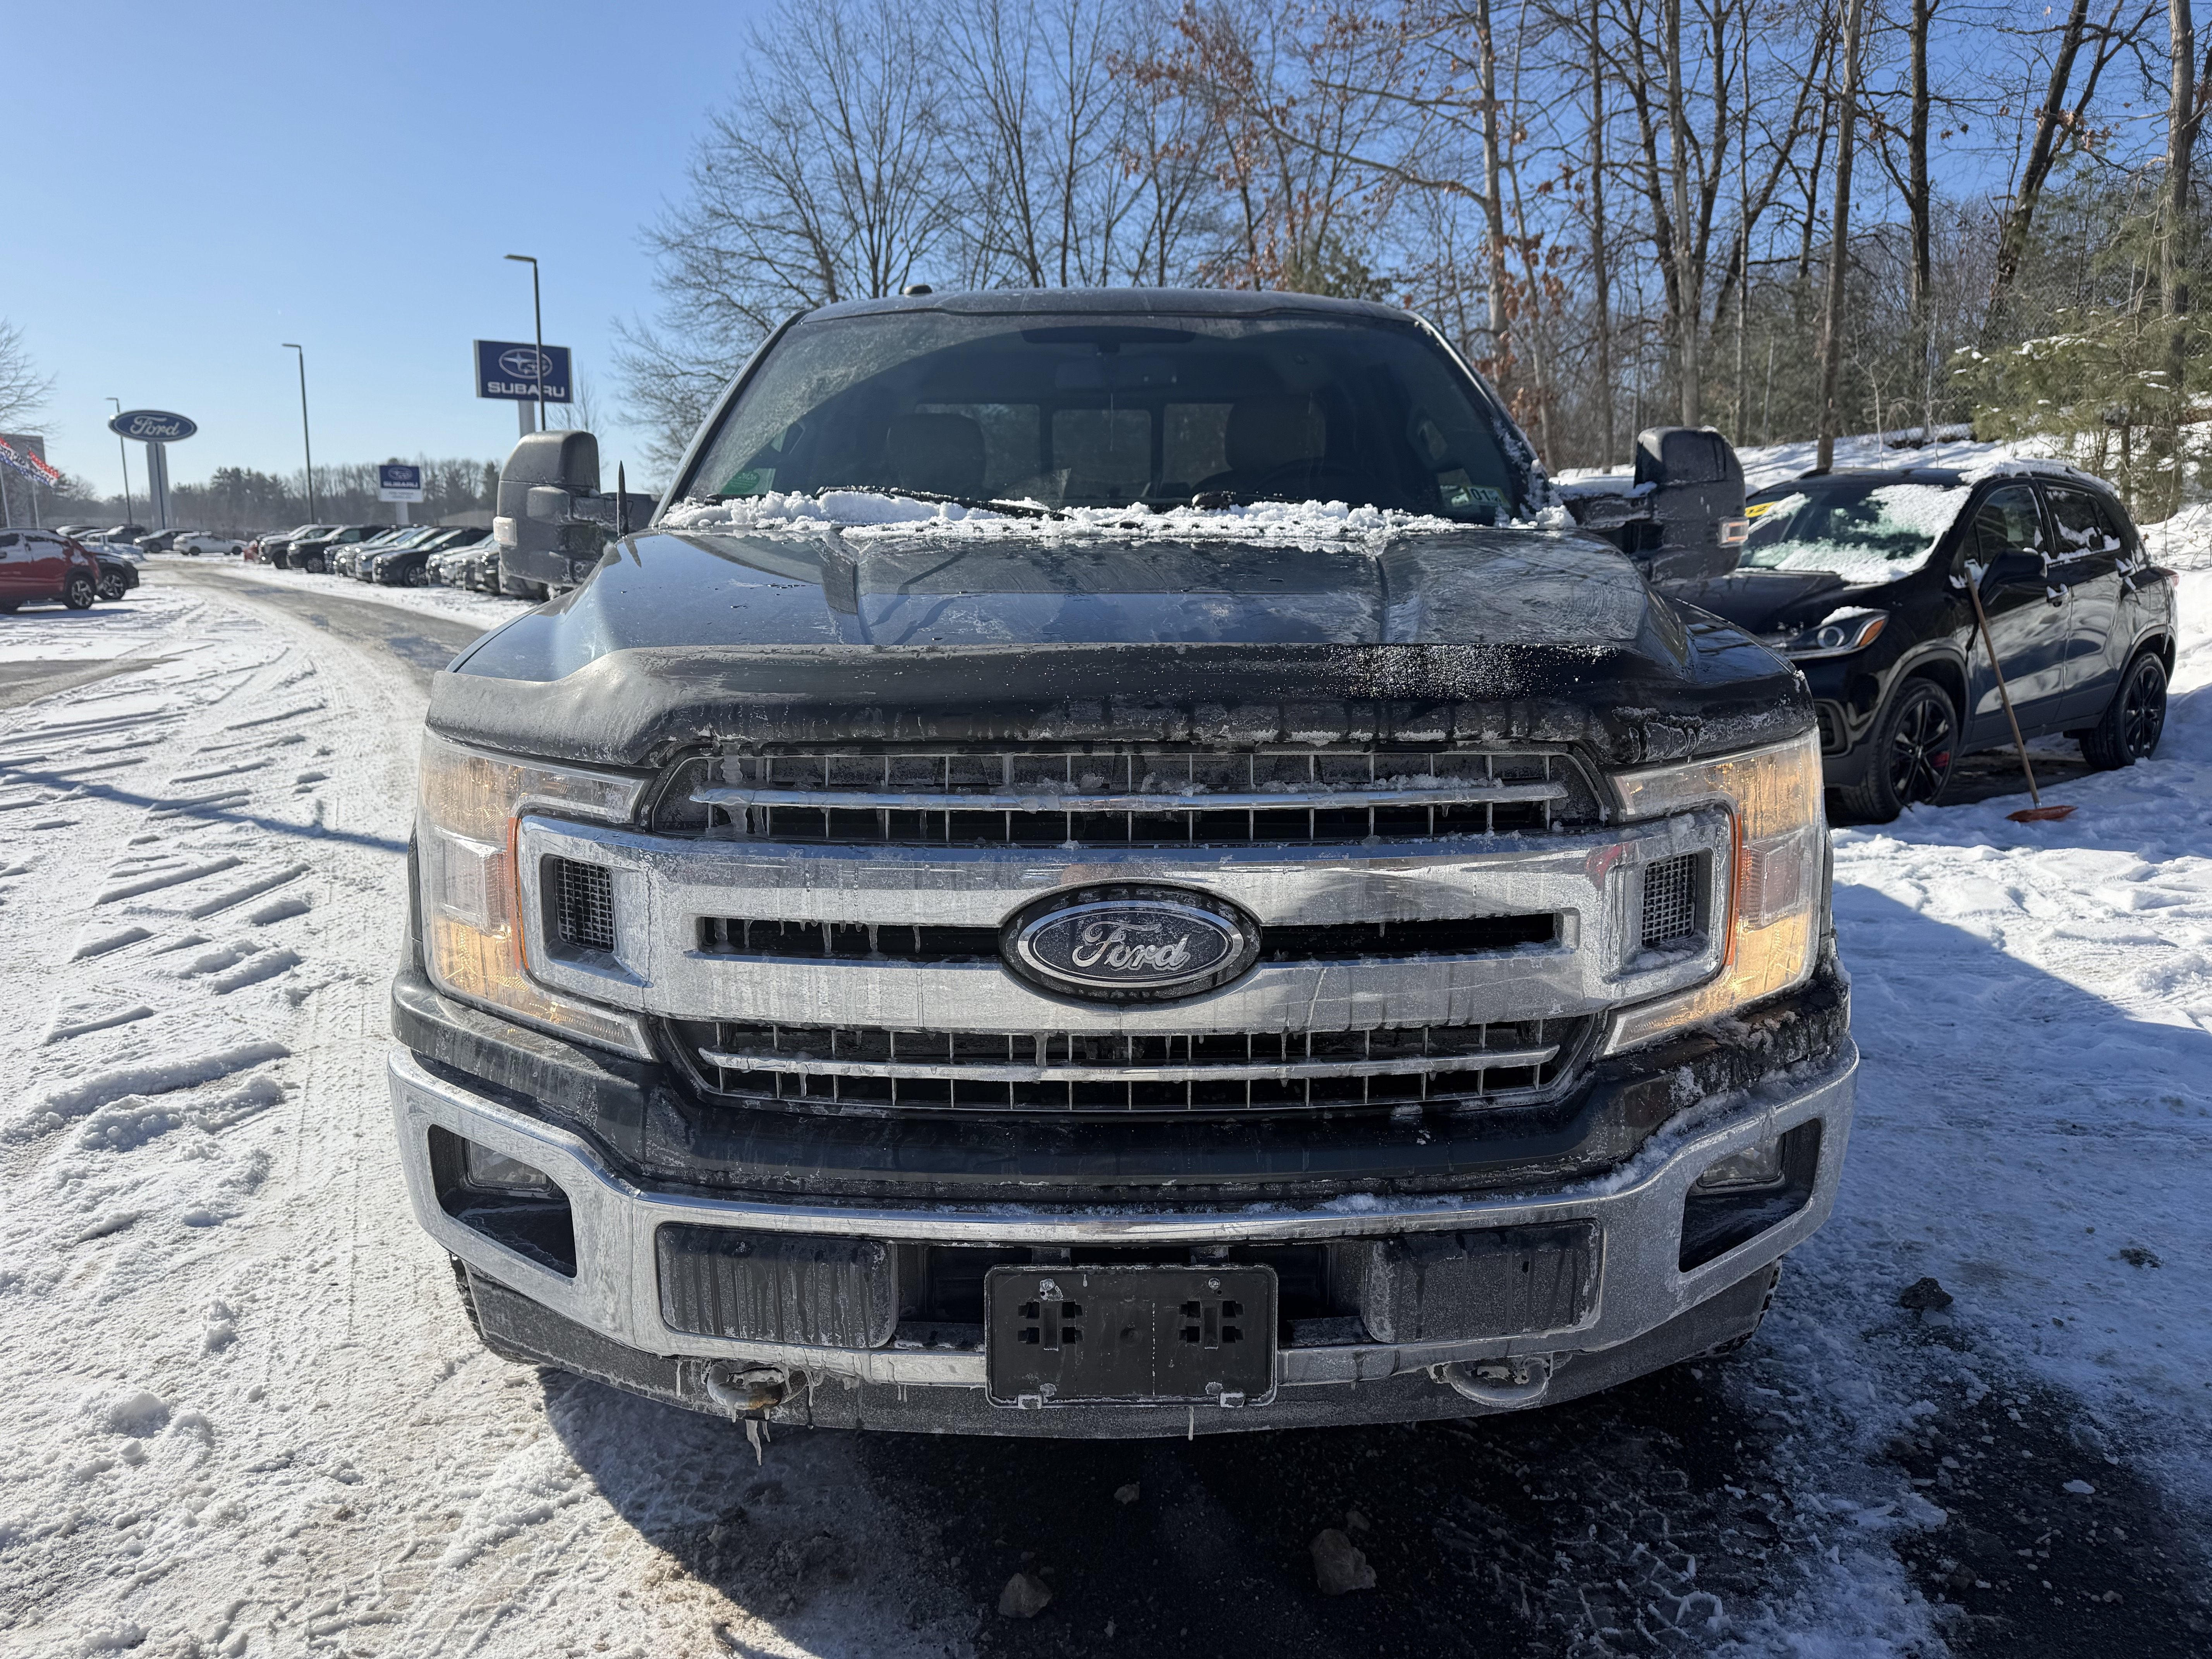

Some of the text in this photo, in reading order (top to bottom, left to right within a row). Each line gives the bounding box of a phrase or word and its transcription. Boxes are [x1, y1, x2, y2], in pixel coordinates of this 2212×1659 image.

[488, 381, 565, 398] SUBARU
[130, 415, 180, 435] Ford
[1072, 921, 1190, 969] Ford
